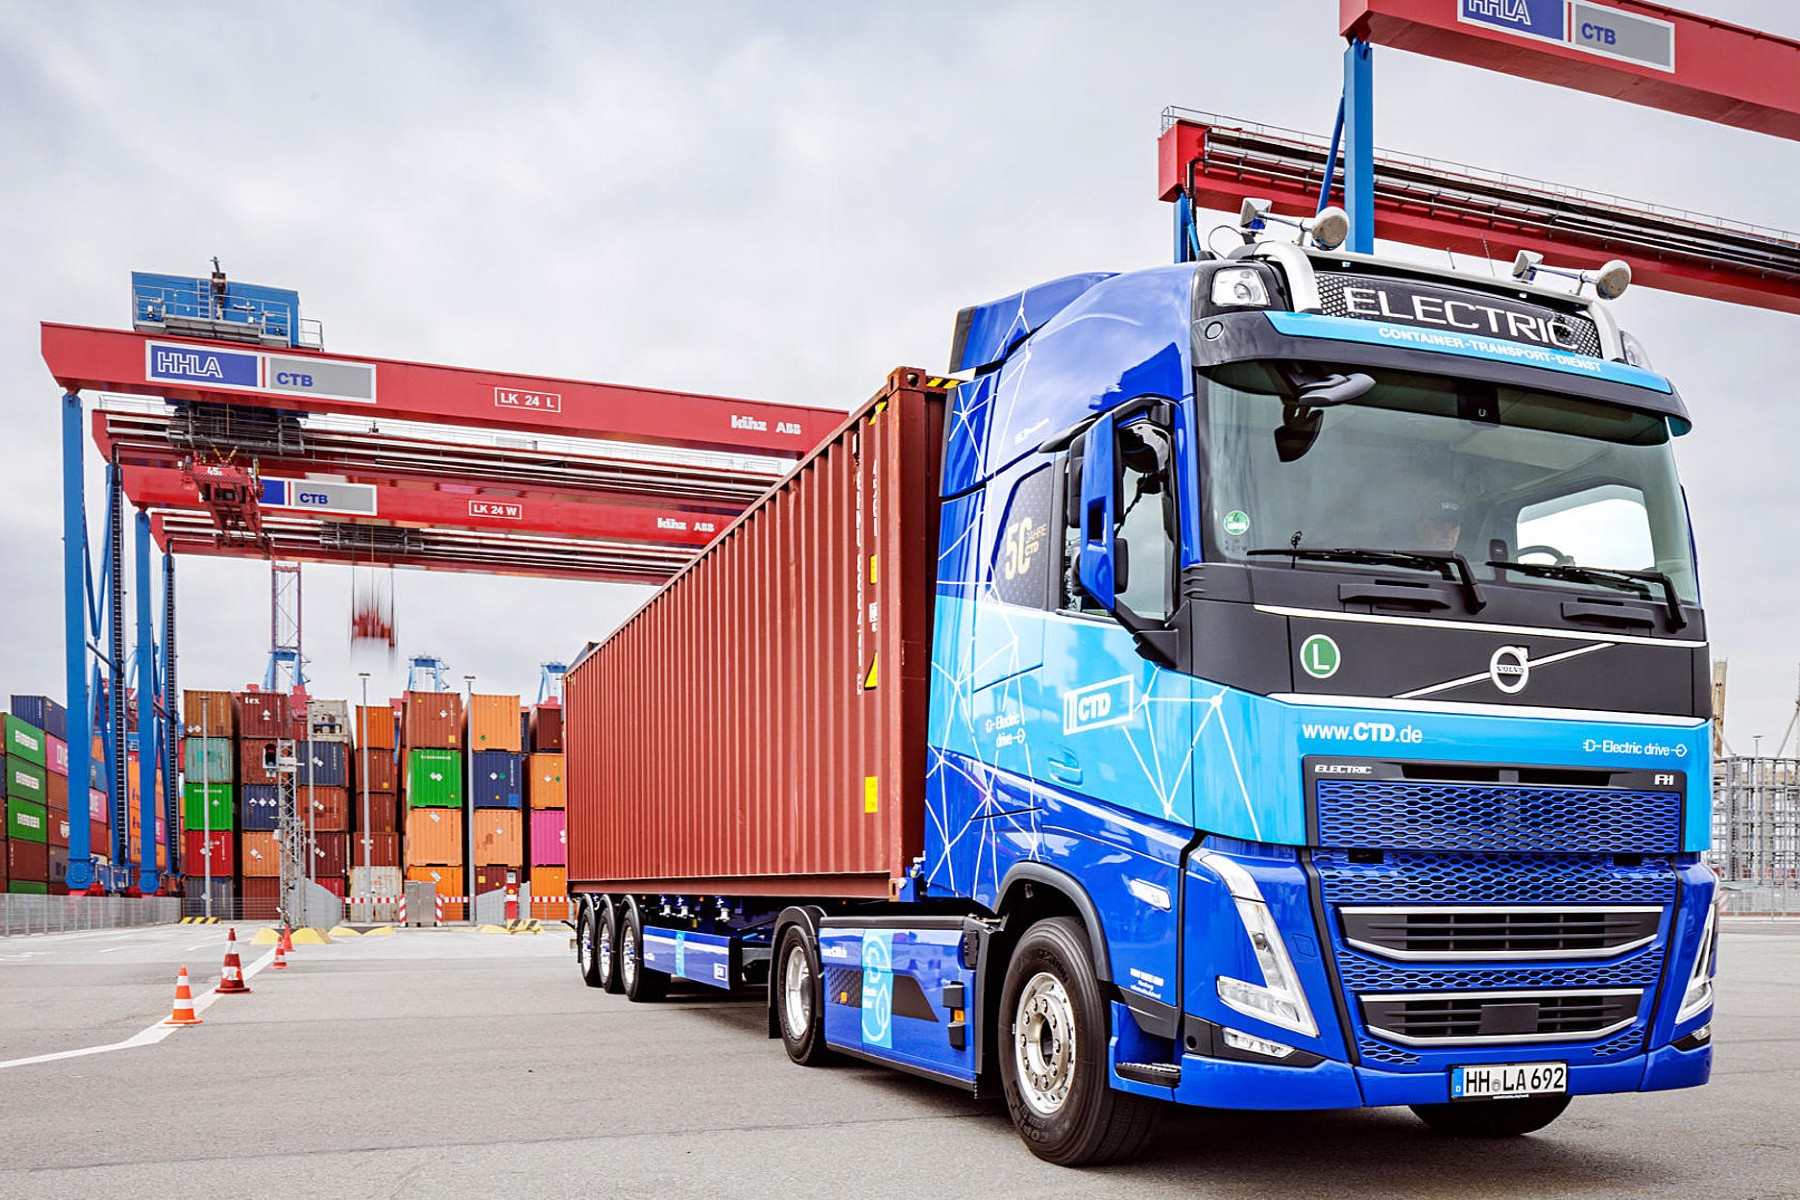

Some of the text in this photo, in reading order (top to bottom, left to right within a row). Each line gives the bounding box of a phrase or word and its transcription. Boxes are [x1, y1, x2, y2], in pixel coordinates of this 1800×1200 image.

[1581, 22, 1616, 45] CTB
[1343, 286, 1577, 350] ELECTRIC
[157, 351, 224, 378] HHLA
[276, 372, 313, 387] CTB
[500, 392, 555, 408] LK 24 L
[775, 421, 801, 435] ABB
[299, 492, 328, 505] CTB
[473, 504, 517, 516] LK 24 W
[1312, 643, 1330, 670] L
[1496, 665, 1525, 674] VOLVO
[1077, 692, 1112, 722] CTD
[1302, 722, 1423, 744] www.CTD.de
[1602, 739, 1670, 756] Electric drive
[1314, 764, 1373, 774] ELECTRIC
[1654, 774, 1675, 786] FH
[1466, 1070, 1490, 1093] HH
[1503, 1068, 1526, 1092] LA
[1531, 1067, 1564, 1090] 692
